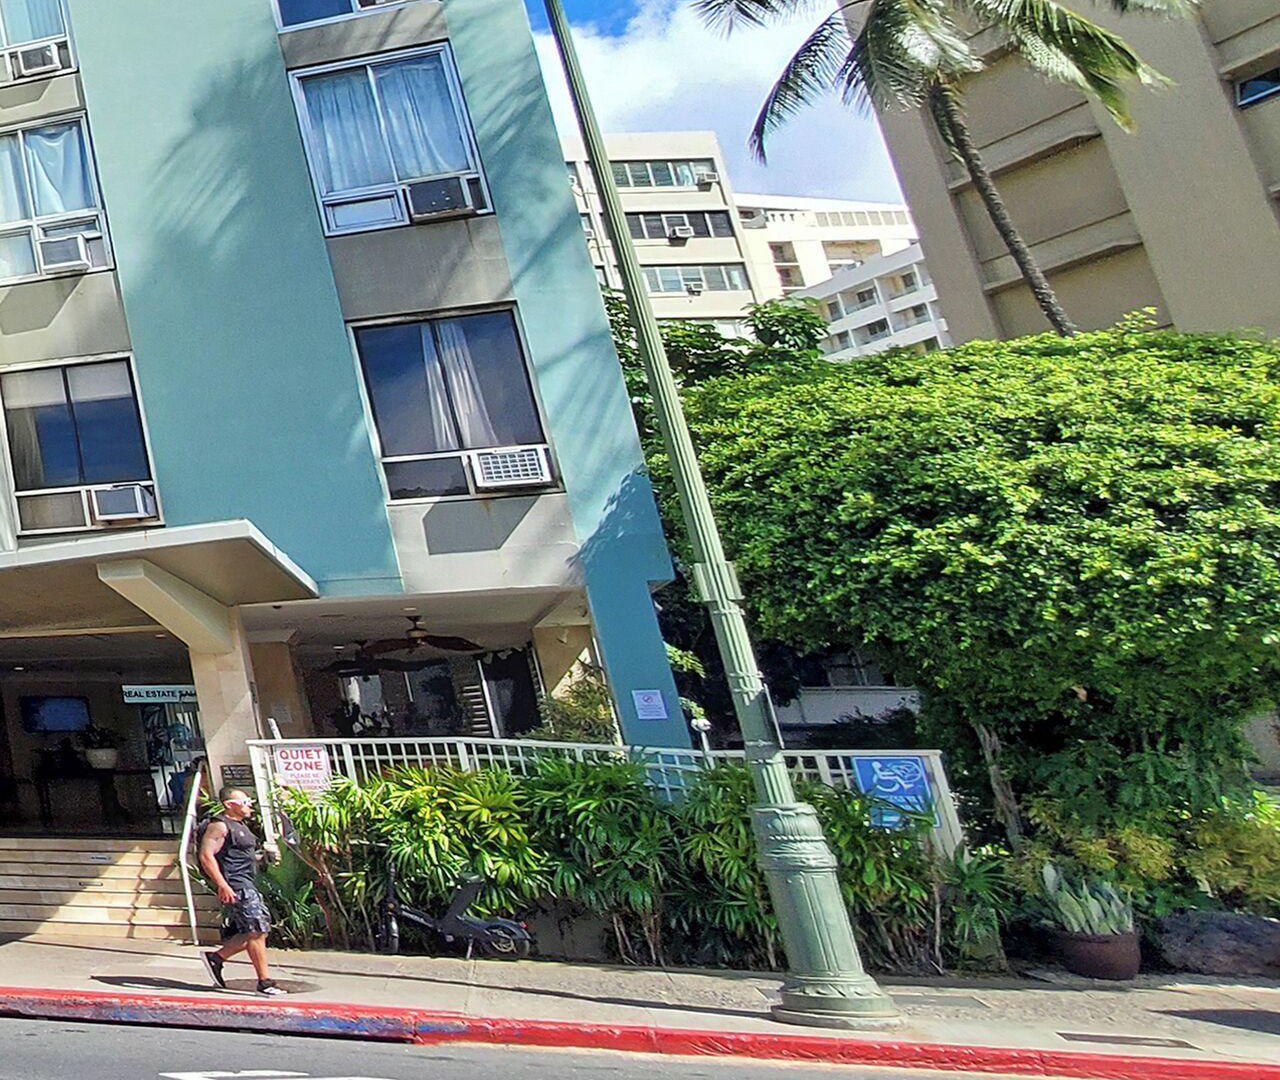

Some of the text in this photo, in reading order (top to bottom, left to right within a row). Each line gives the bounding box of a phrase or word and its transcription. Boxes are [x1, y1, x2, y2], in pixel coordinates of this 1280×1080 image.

[123, 690, 144, 698] REAL
[146, 690, 177, 698] ESTATE
[279, 749, 322, 760] QUIET
[284, 761, 323, 771] ZONE
